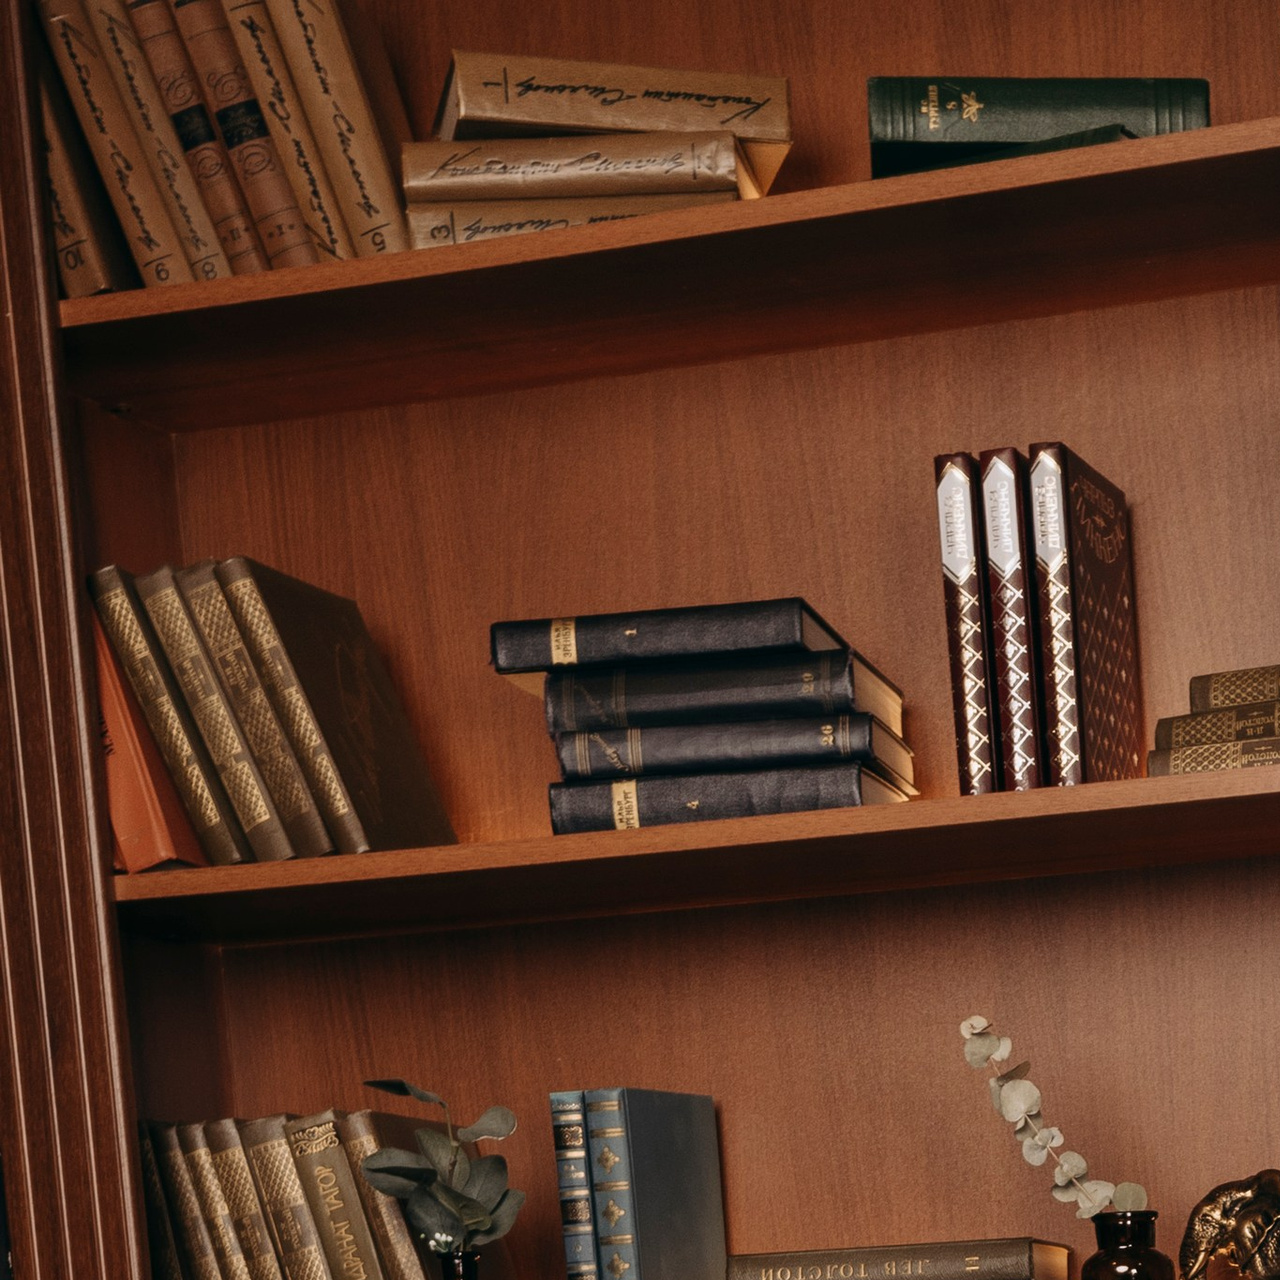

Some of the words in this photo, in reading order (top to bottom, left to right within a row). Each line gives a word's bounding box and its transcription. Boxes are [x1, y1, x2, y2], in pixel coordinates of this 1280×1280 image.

[369, 230, 388, 252] 5
[953, 486, 969, 560] ДИККЕНС
[1044, 475, 1061, 550] ДИККЕНС
[819, 724, 834, 746] 26
[311, 1161, 345, 1215] ТАГОР
[883, 1258, 930, 1276] ЛЕВ
